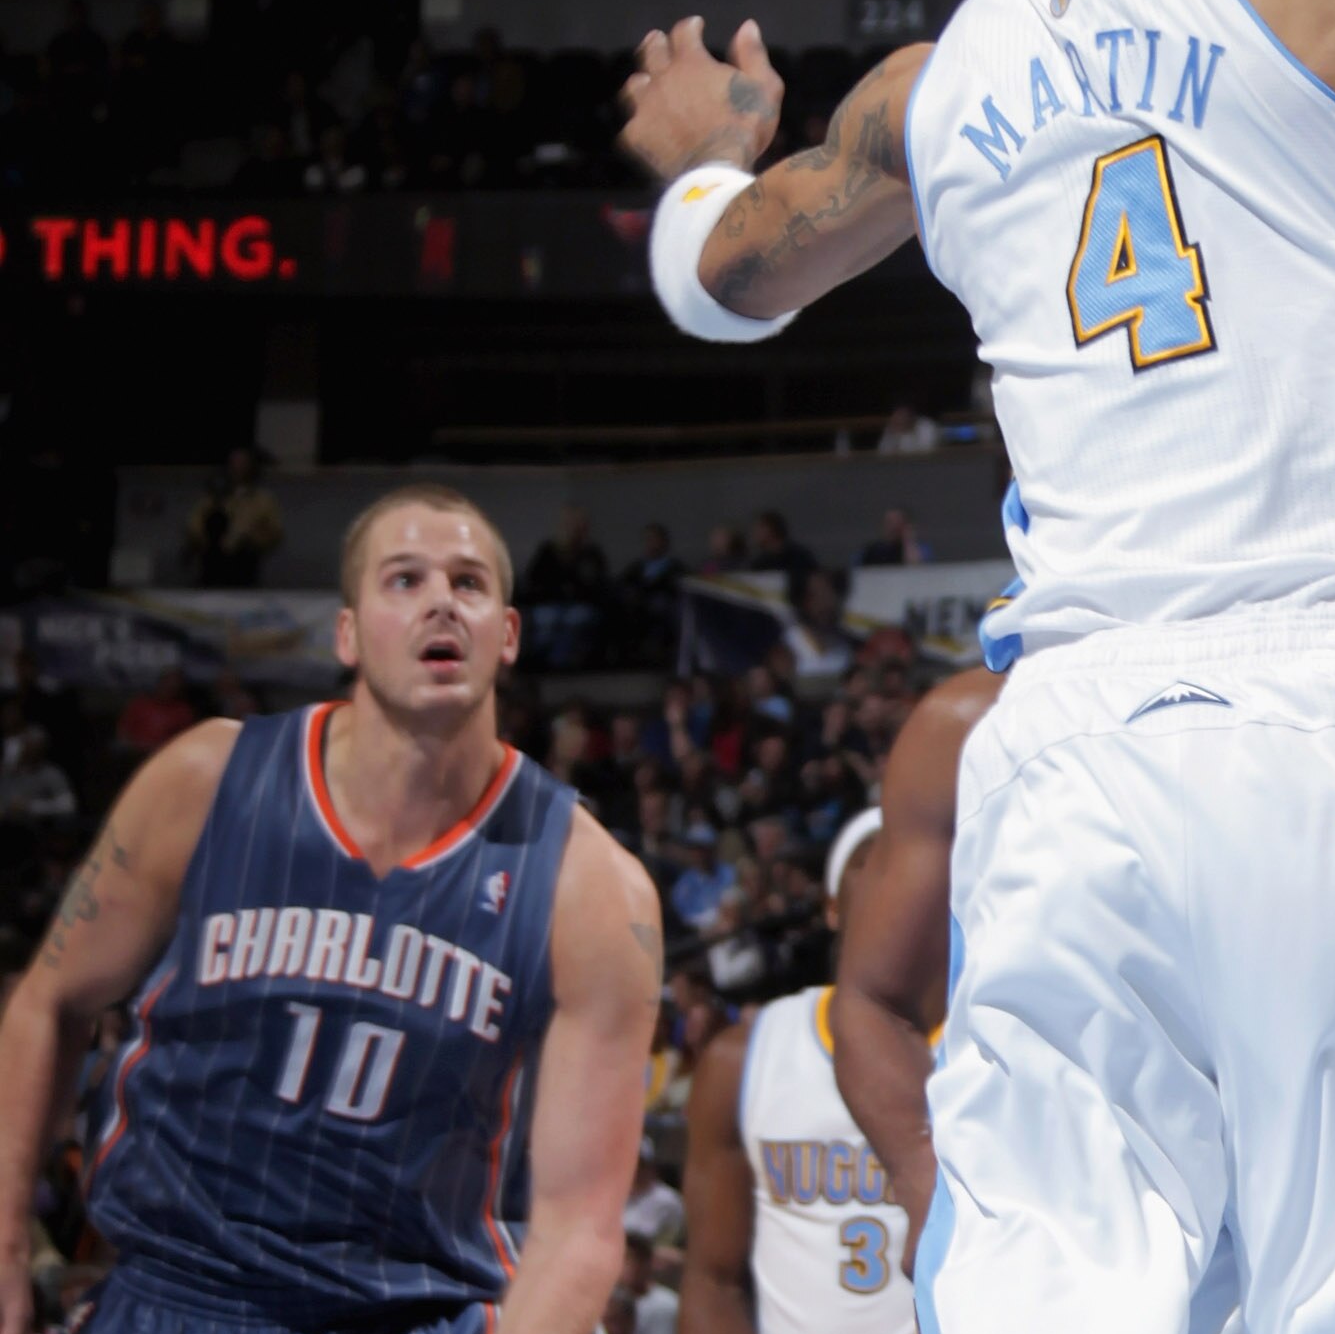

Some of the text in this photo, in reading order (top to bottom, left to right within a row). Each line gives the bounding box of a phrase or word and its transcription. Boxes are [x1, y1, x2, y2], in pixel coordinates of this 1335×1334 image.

[30, 214, 298, 283] THING.
[1066, 133, 1218, 373] 4
[196, 905, 512, 1043] CHARLOTTE
[275, 1001, 406, 1122] 10
[838, 1214, 890, 1295] 3
